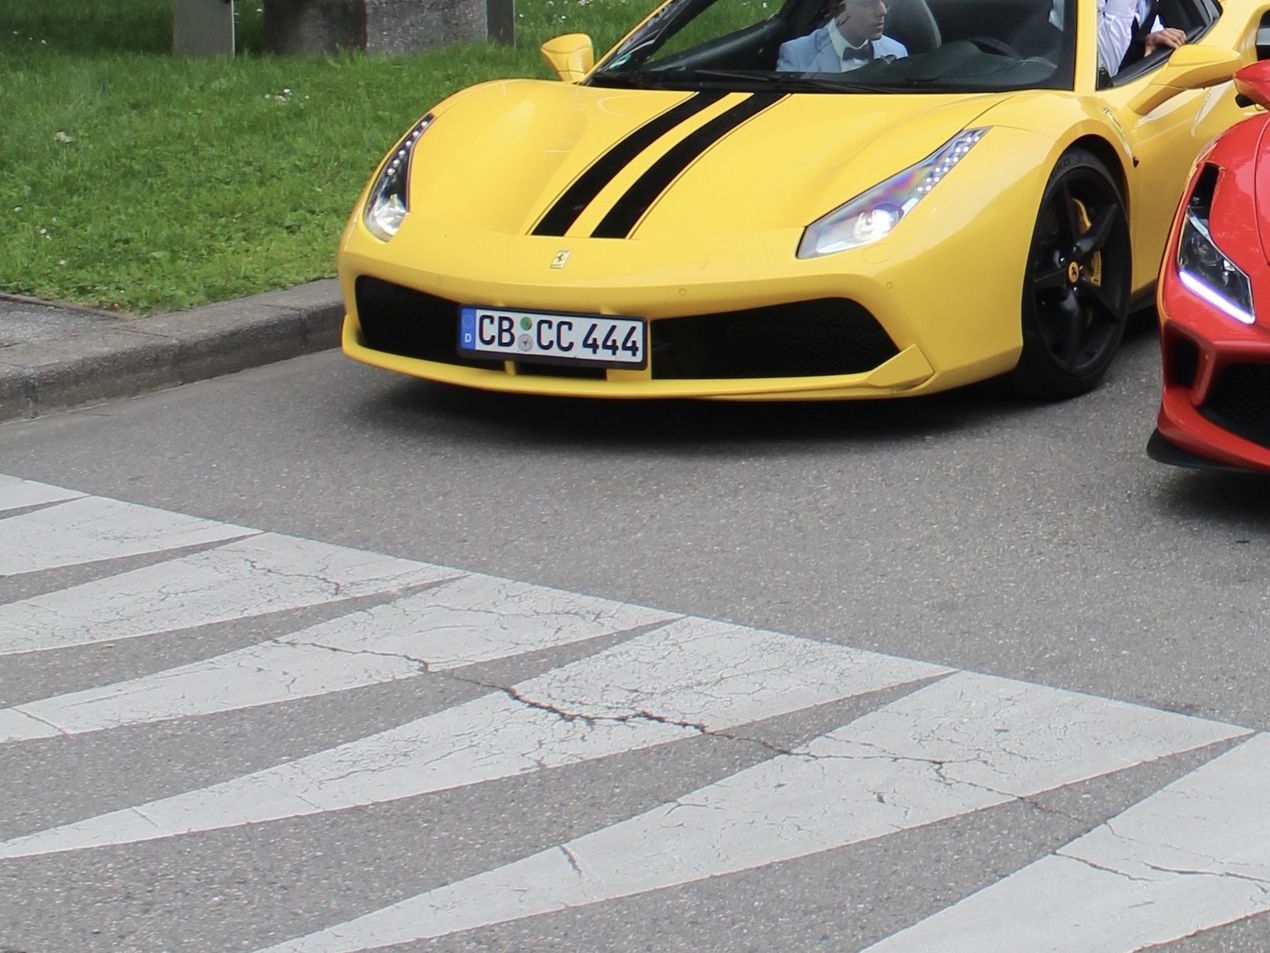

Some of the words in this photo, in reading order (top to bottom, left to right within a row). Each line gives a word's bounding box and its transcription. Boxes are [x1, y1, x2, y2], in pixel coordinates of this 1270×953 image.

[464, 333, 472, 343] D
[478, 314, 516, 347] CB
[536, 319, 575, 352] CC
[582, 323, 639, 357] 444
